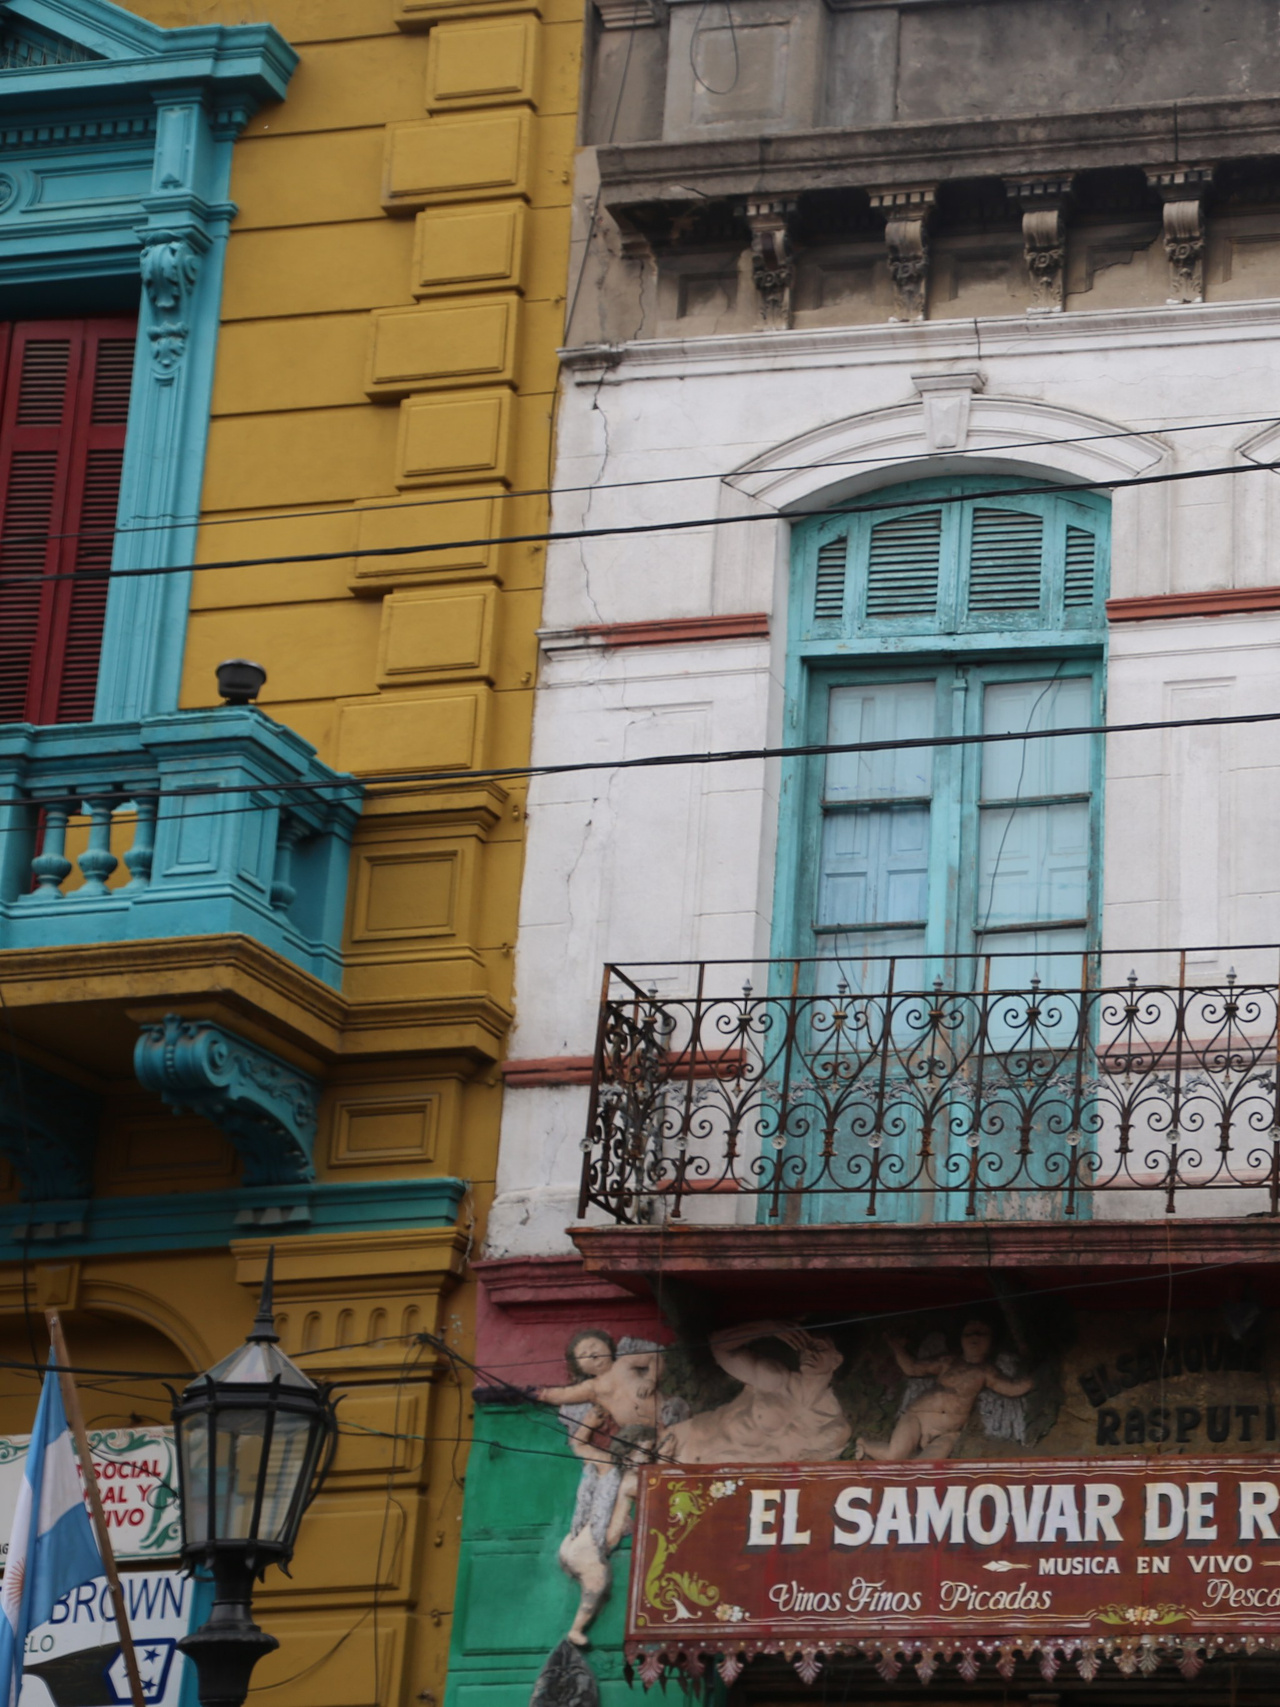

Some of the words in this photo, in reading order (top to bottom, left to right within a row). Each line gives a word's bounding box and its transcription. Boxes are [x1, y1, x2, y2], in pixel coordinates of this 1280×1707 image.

[93, 1459, 162, 1480] SOCIAL
[747, 1488, 812, 1546] EL
[833, 1483, 1125, 1547] SAMOVAR
[1143, 1481, 1219, 1541] DE
[1037, 1556, 1121, 1576] MUSICA
[1136, 1555, 1171, 1574] EN
[1187, 1553, 1254, 1575] VIVO
[48, 1576, 186, 1625] BROWN
[768, 1579, 842, 1612] Vinos
[844, 1576, 923, 1612] Finos
[938, 1579, 1053, 1612] Picadas
